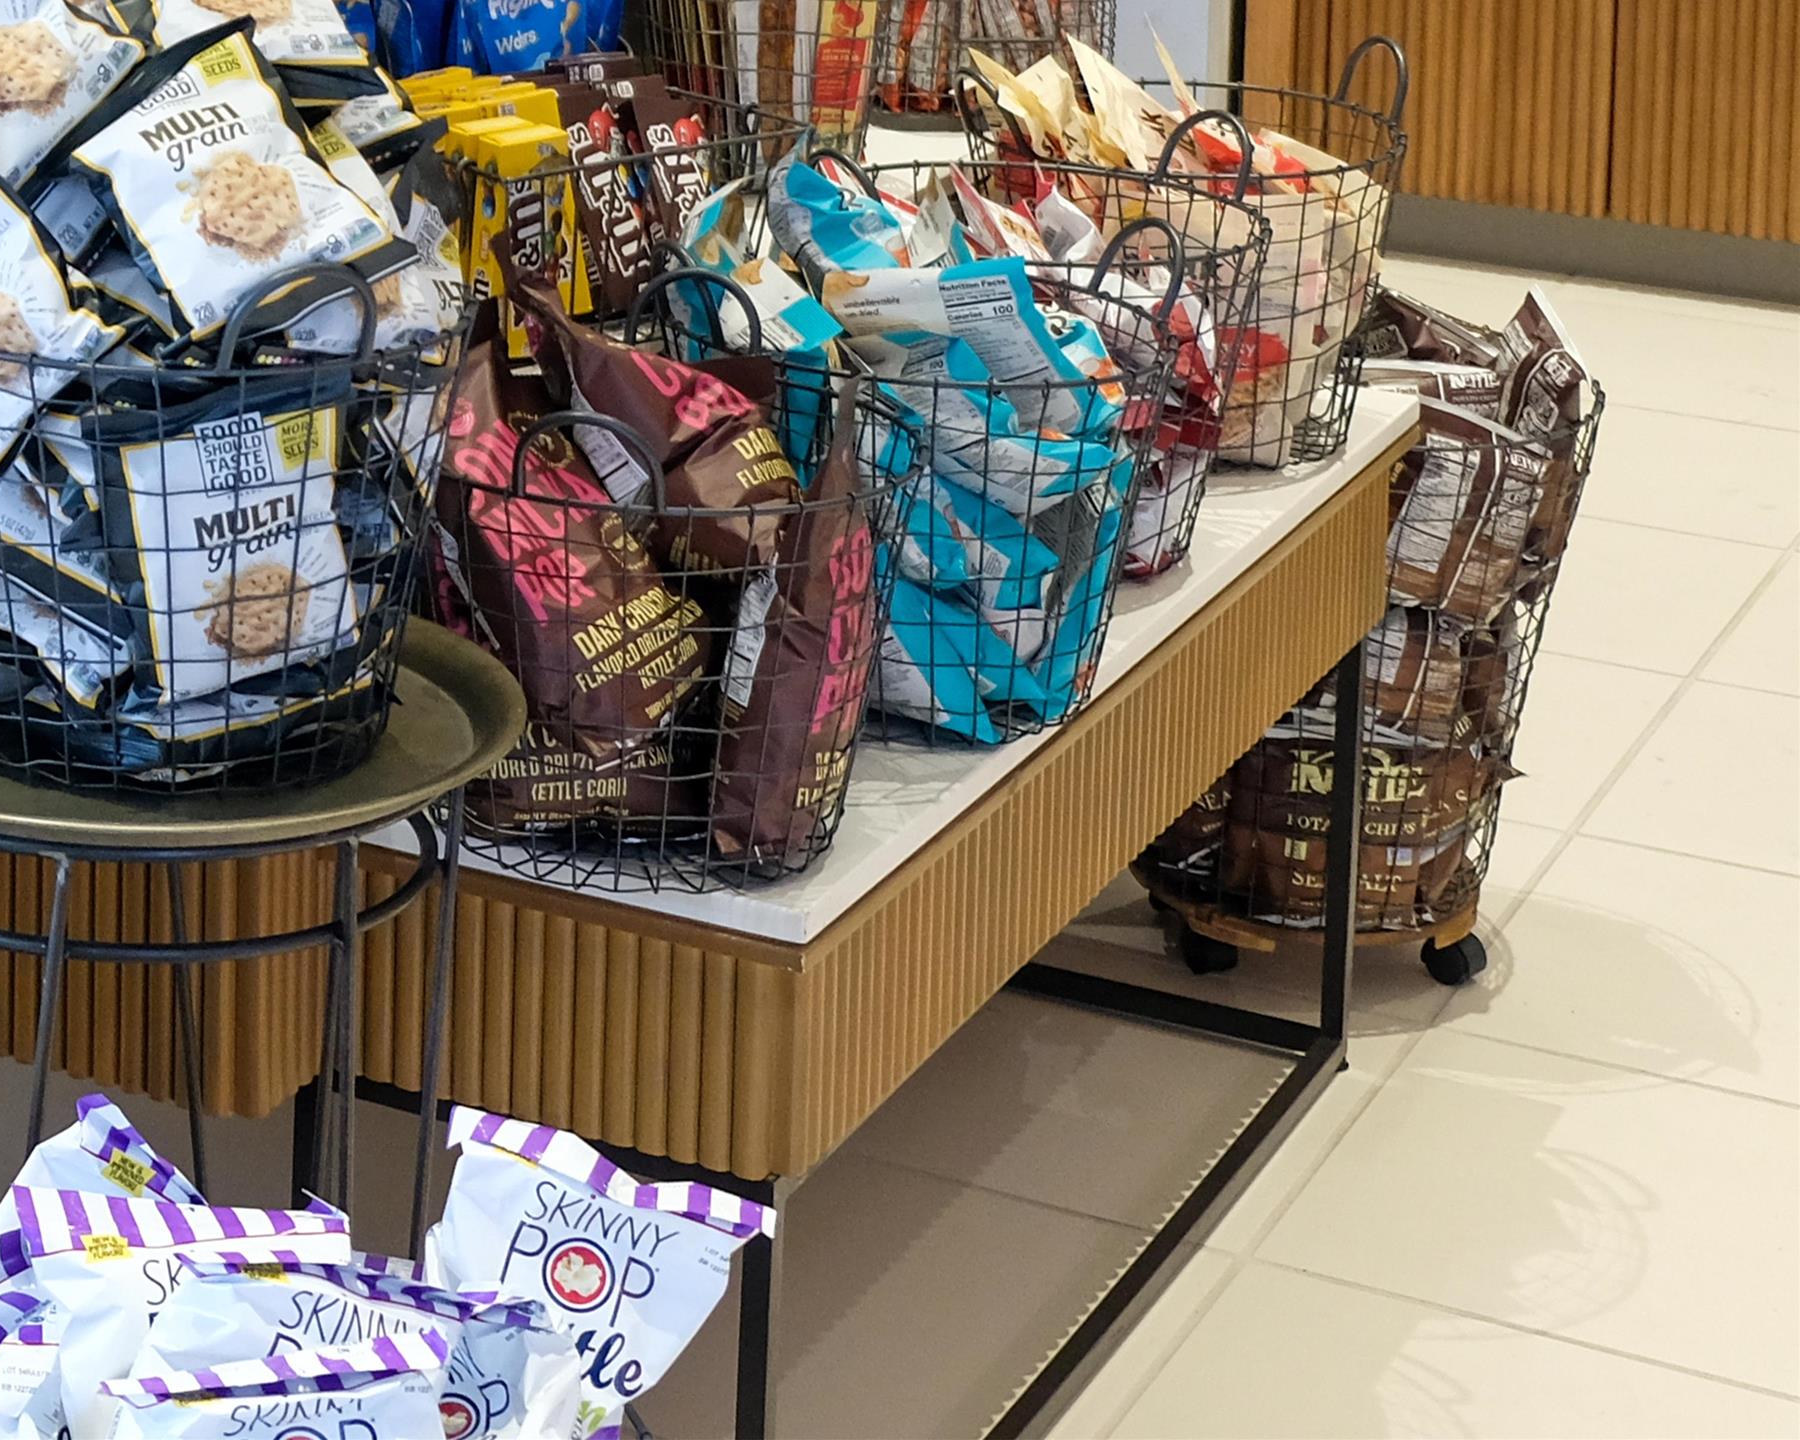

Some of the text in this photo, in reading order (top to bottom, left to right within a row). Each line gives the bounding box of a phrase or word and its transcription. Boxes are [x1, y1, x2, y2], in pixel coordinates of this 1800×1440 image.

[202, 58, 242, 78] SEEDS
[137, 101, 241, 153] MULTI
[166, 121, 249, 173] grain
[992, 303, 1014, 316] 100
[200, 416, 259, 444] FOOD
[203, 434, 263, 460] SHOULD
[206, 448, 265, 475] TASTE
[210, 465, 268, 492] GOOD
[193, 492, 296, 550] MULTI
[207, 520, 294, 574] grain
[572, 610, 625, 661] DARK
[1360, 874, 1403, 893] ALT
[524, 1180, 680, 1258] SKINNY
[499, 1219, 657, 1328] POP
